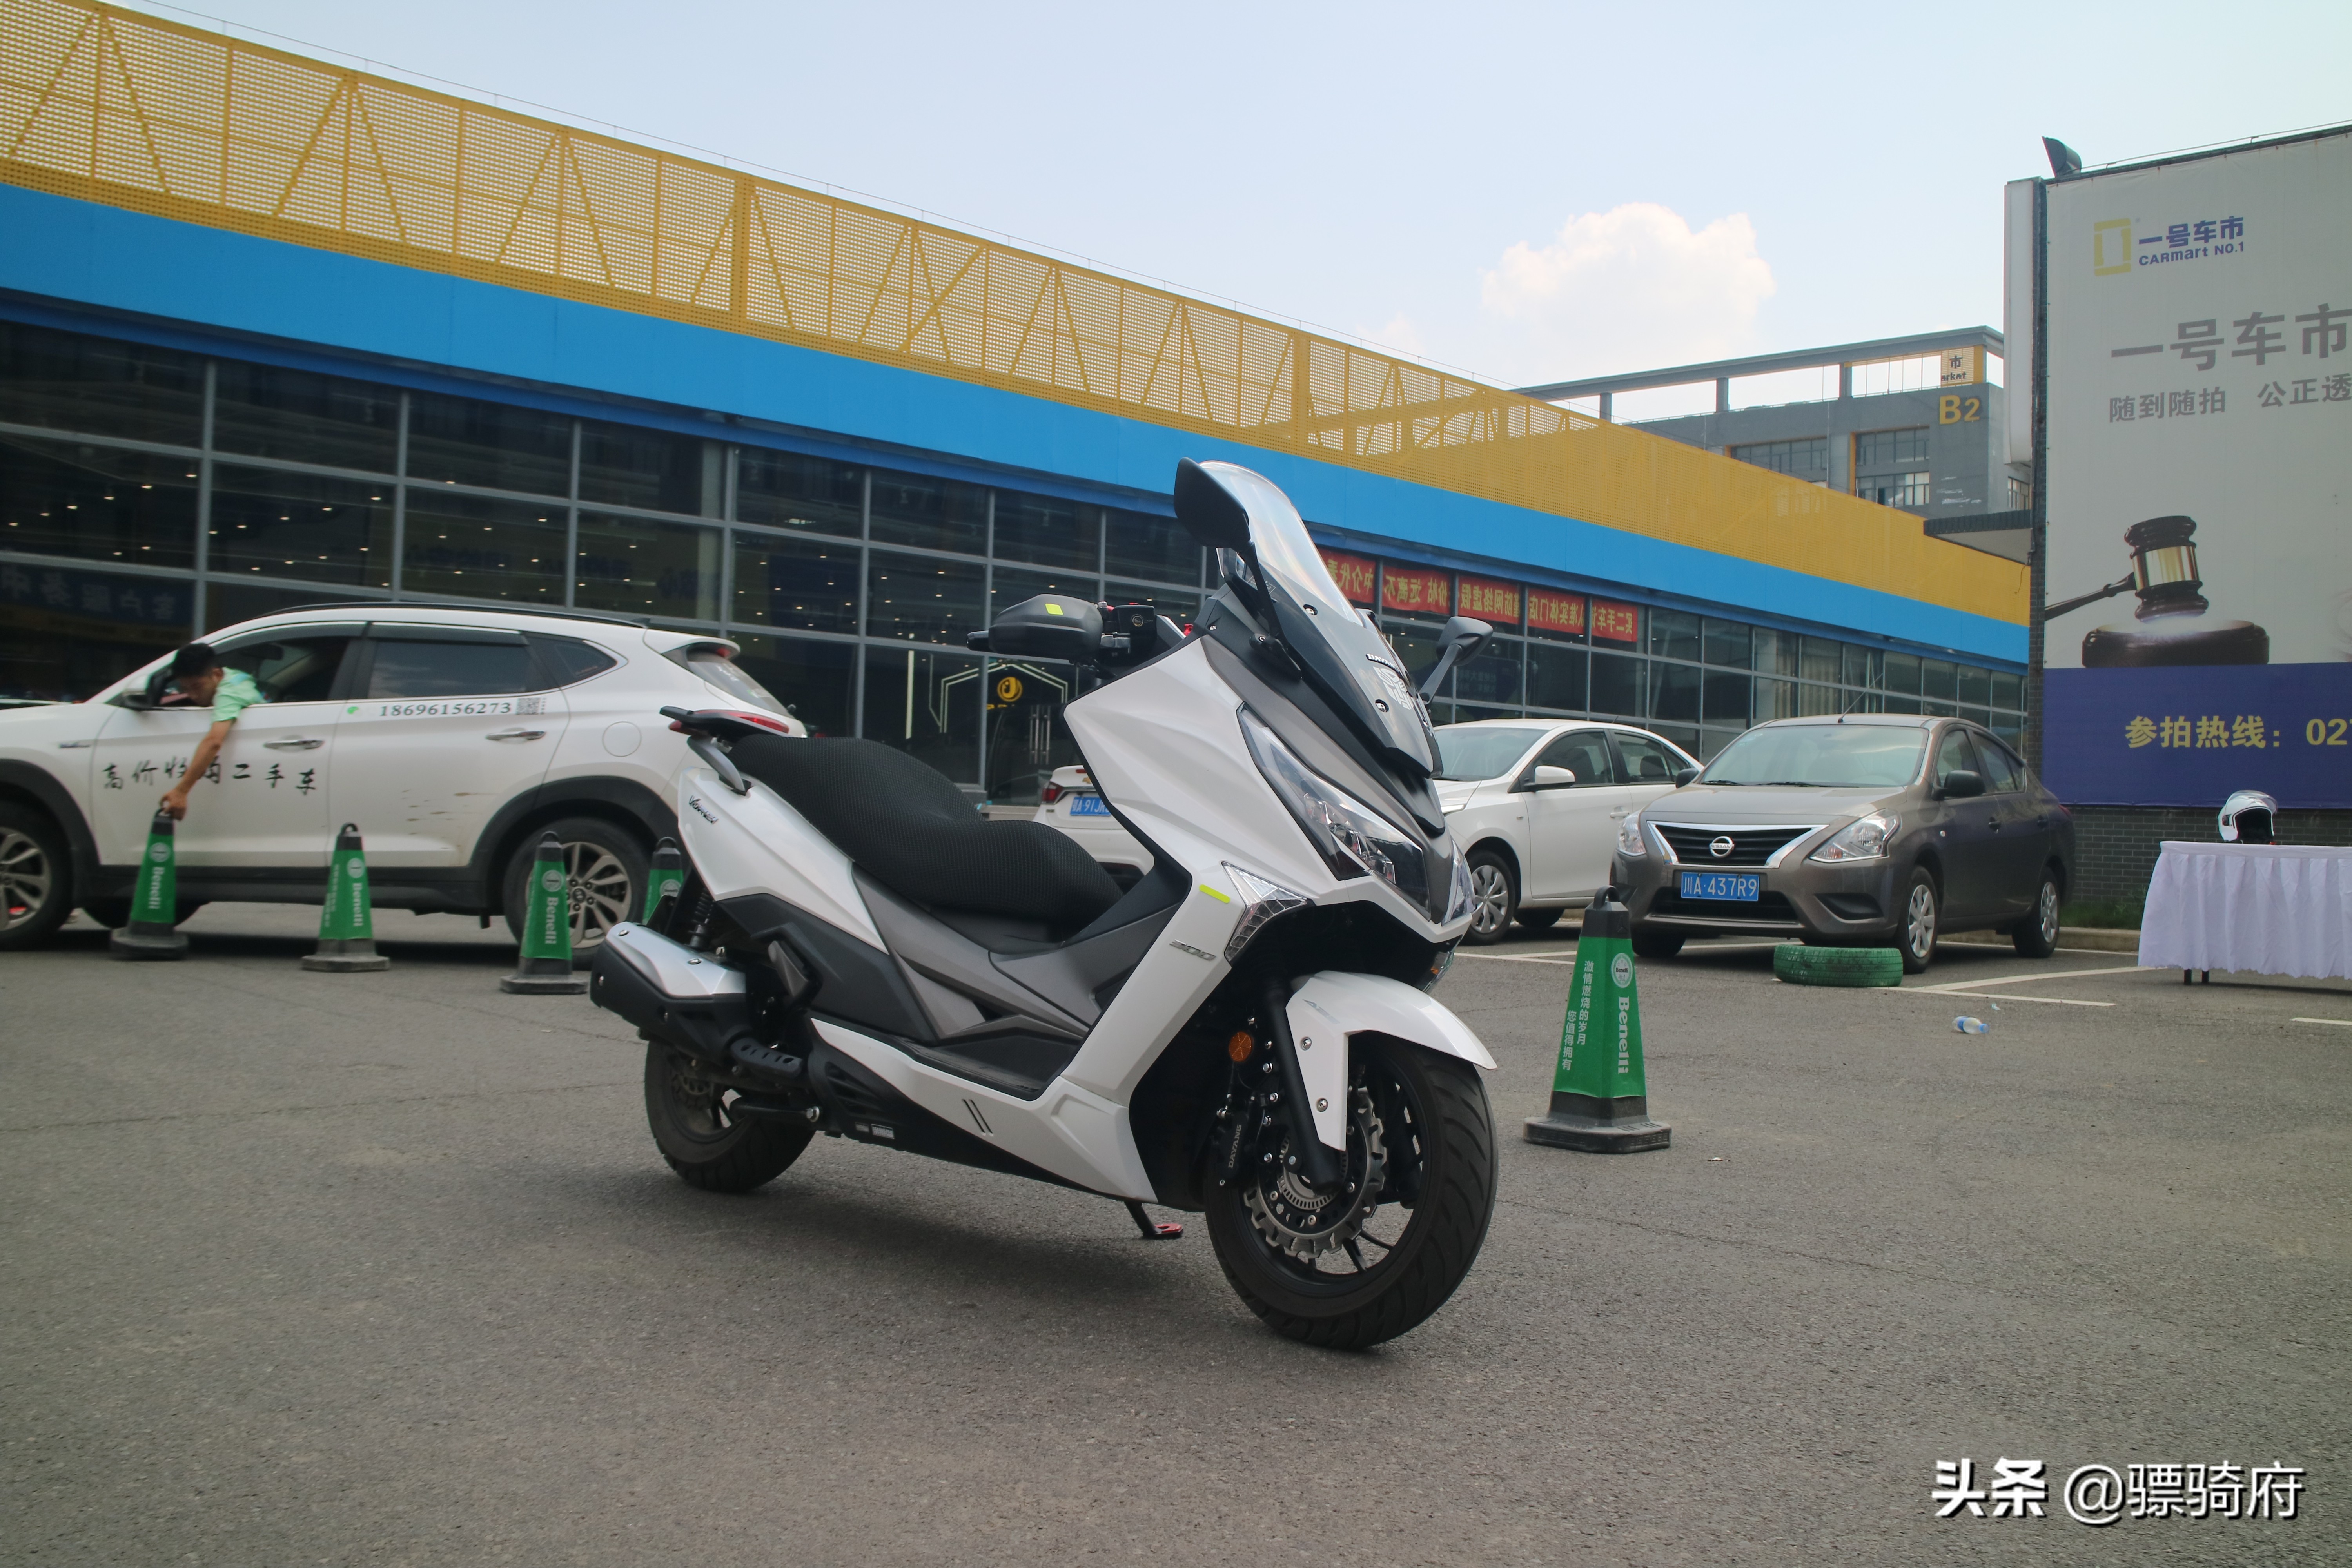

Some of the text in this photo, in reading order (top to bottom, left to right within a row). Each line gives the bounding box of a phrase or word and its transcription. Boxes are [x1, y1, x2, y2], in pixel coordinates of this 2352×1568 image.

[2139, 216, 2243, 248] 一号车市
[2138, 241, 2244, 266] CARmart NO.1
[2111, 303, 2352, 371] 一号车市
[1939, 394, 1980, 425] B2
[2109, 387, 2225, 423] 随到随拍
[379, 702, 512, 717] 18696156273
[2306, 718, 2352, 745] 02
[545, 897, 559, 944] Benelli
[1577, 960, 1594, 1045] 激情燃烧的岁月
[1562, 1009, 1577, 1071] 您值得拥有
[1618, 996, 1630, 1075] Benelli
[1228, 1124, 1242, 1169] DAYANG
